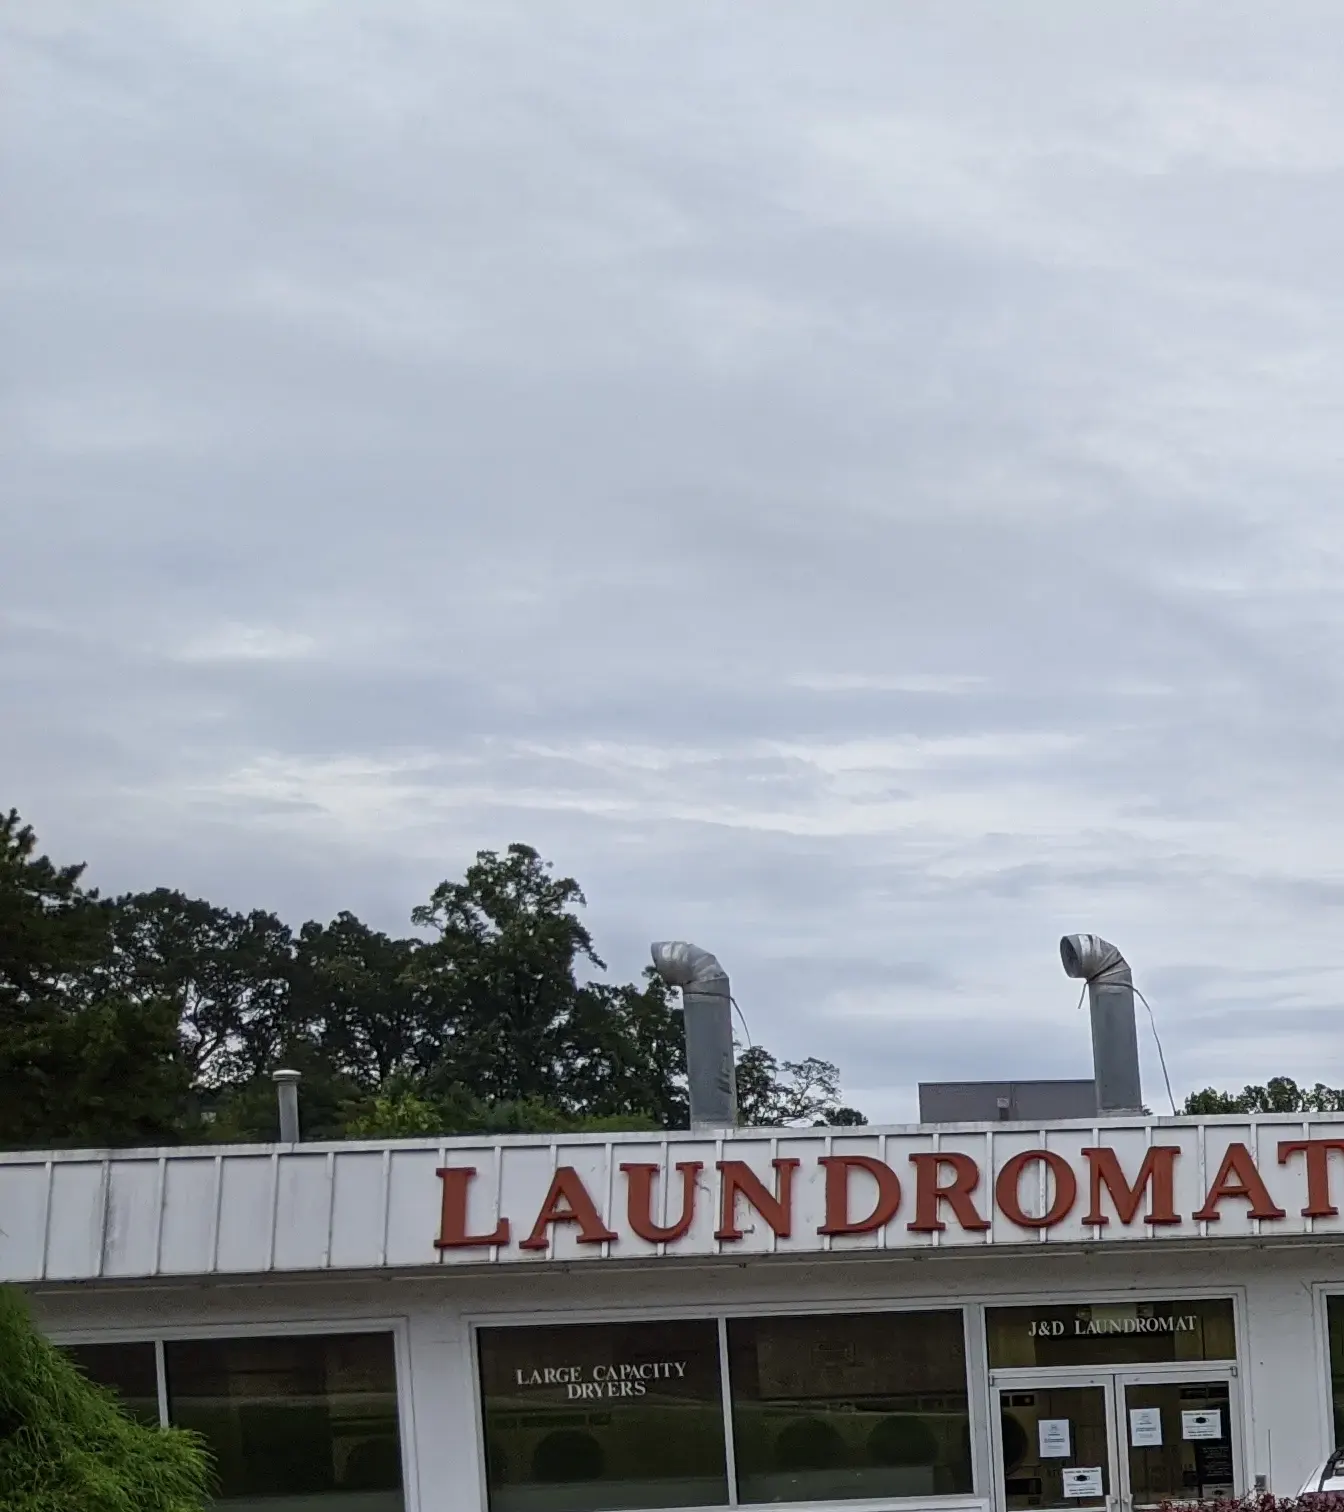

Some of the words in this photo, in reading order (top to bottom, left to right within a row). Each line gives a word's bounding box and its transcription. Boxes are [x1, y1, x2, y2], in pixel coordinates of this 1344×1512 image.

[1028, 1320, 1066, 1337] J&D
[1074, 1315, 1198, 1335] LAUNDROMAT
[516, 1366, 583, 1385] LARGE
[592, 1361, 688, 1381] CAPACITY
[567, 1380, 648, 1400] DRYERS
